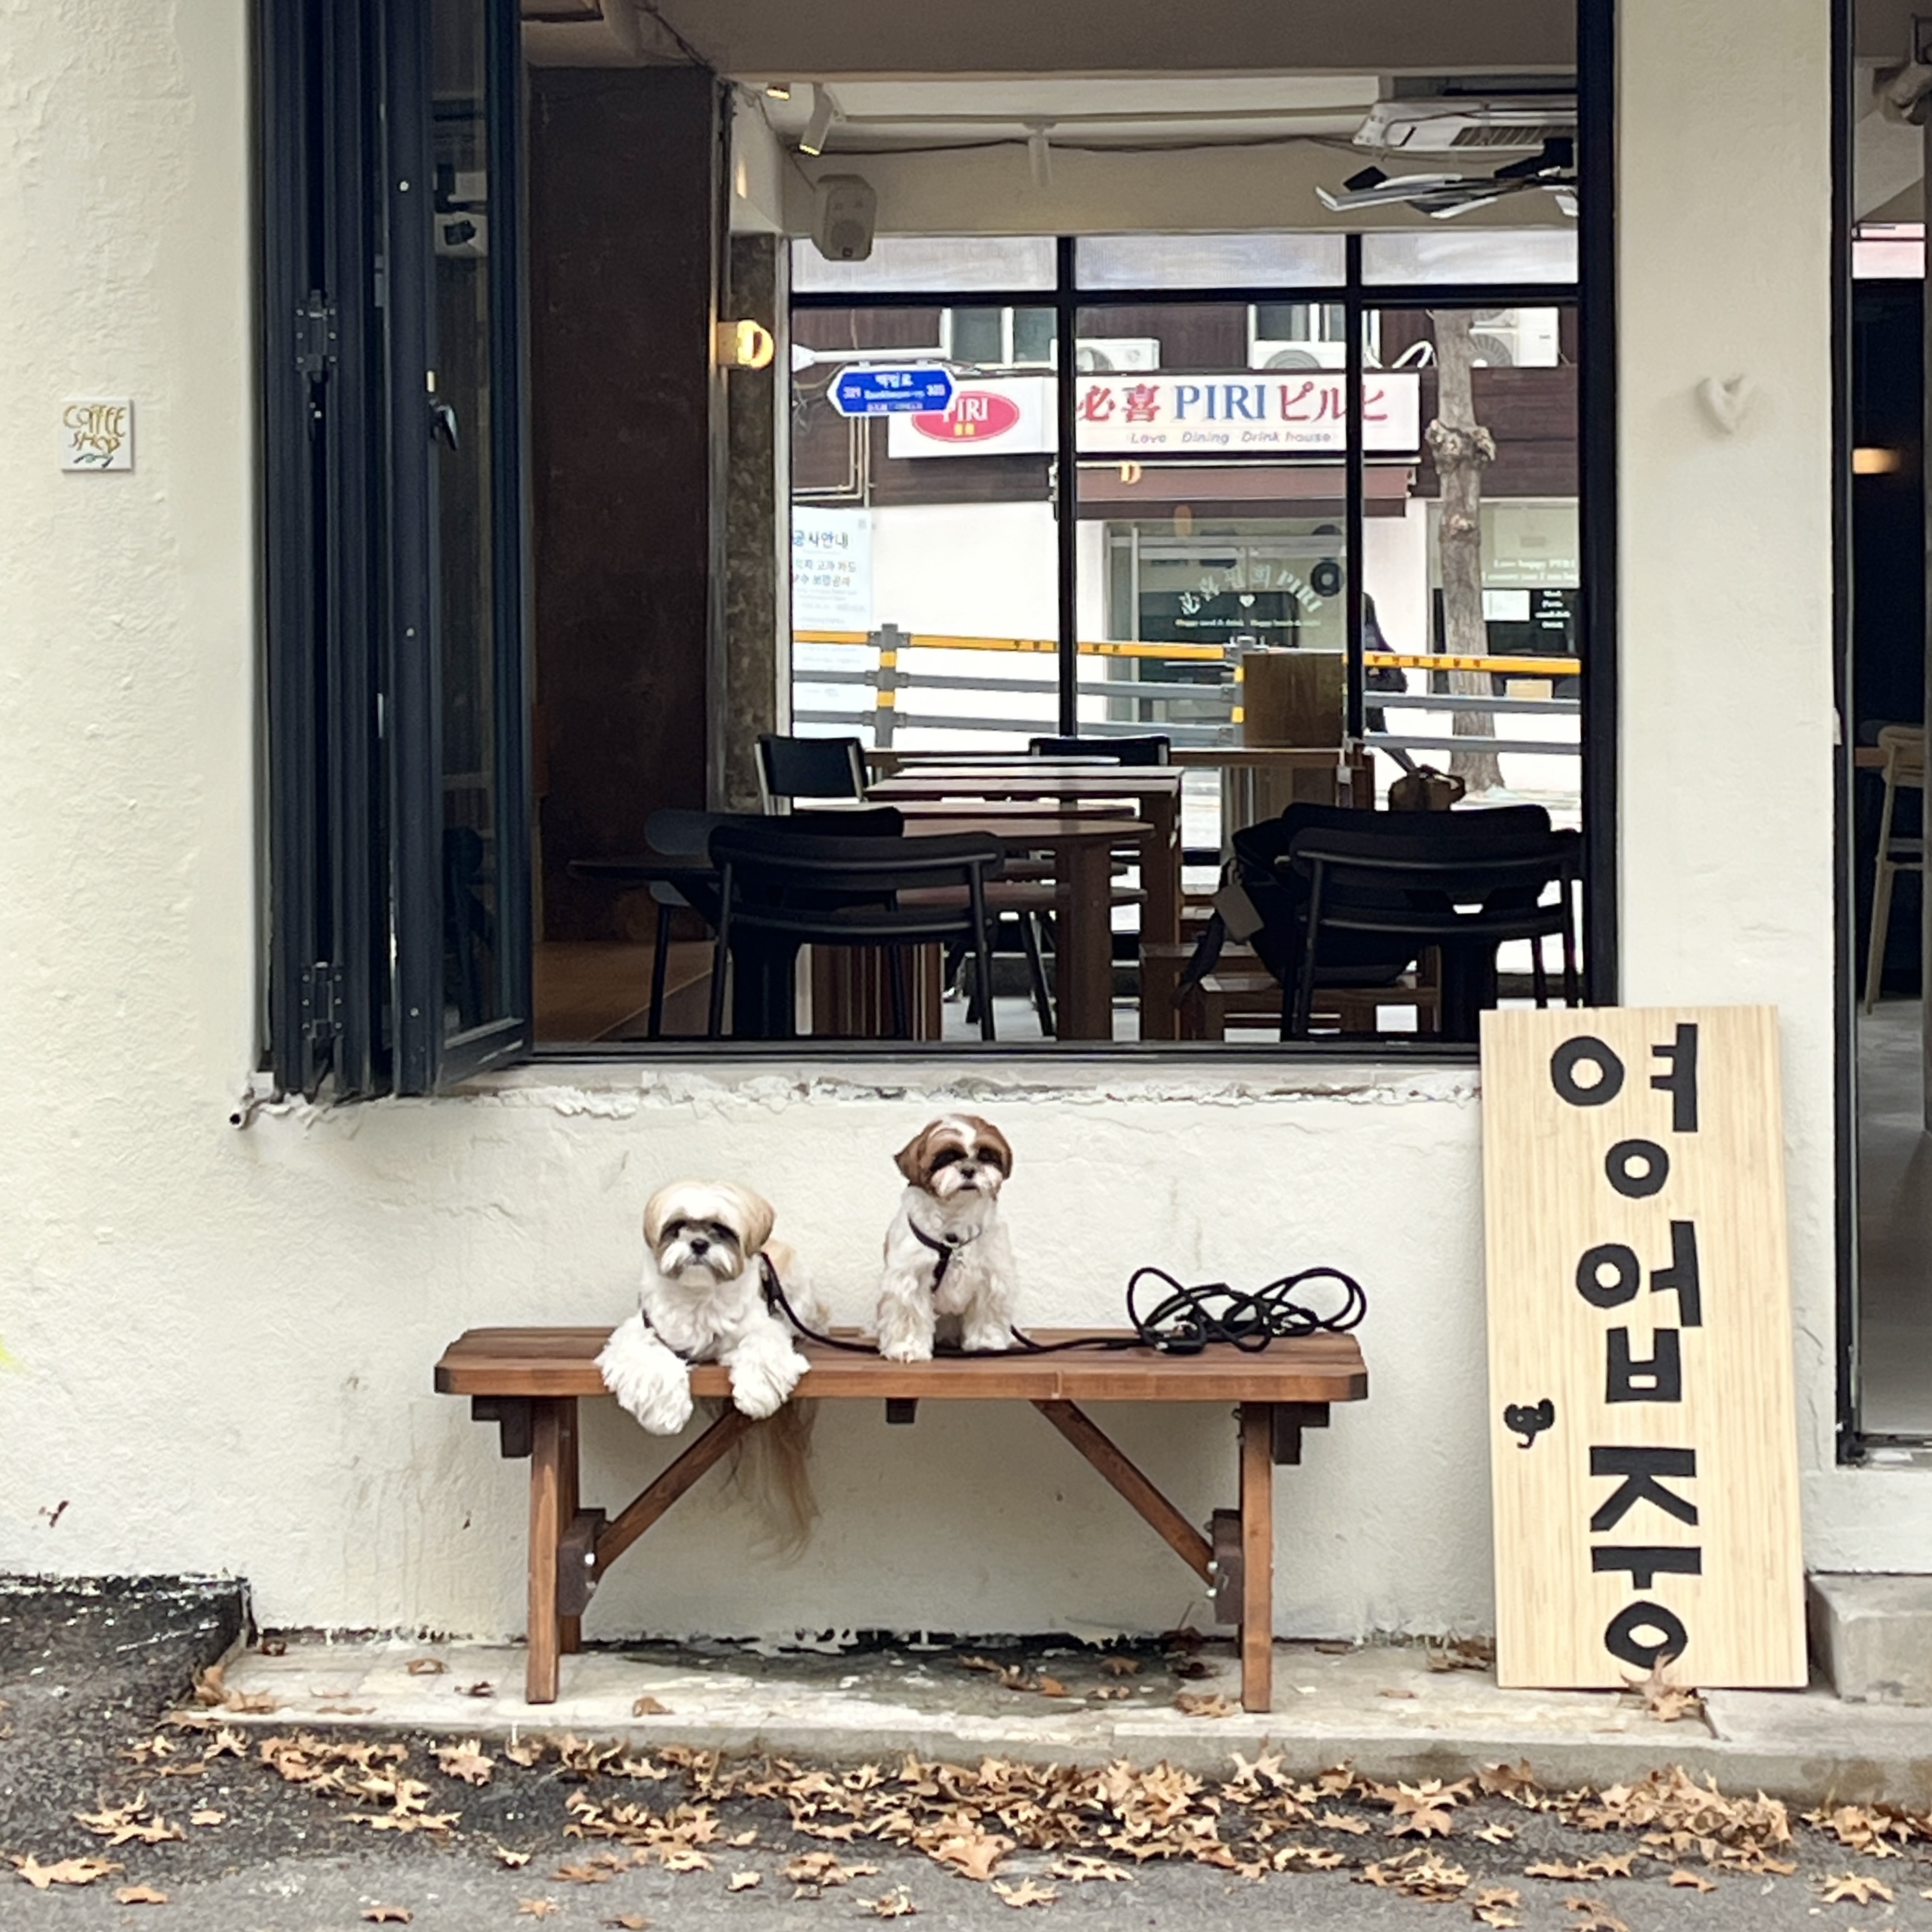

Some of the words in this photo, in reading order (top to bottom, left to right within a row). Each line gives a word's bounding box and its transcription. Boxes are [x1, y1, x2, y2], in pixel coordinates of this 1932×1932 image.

[1174, 384, 1266, 421] PIRI
[1182, 431, 1230, 445] Dining
[1241, 431, 1281, 443] Drink
